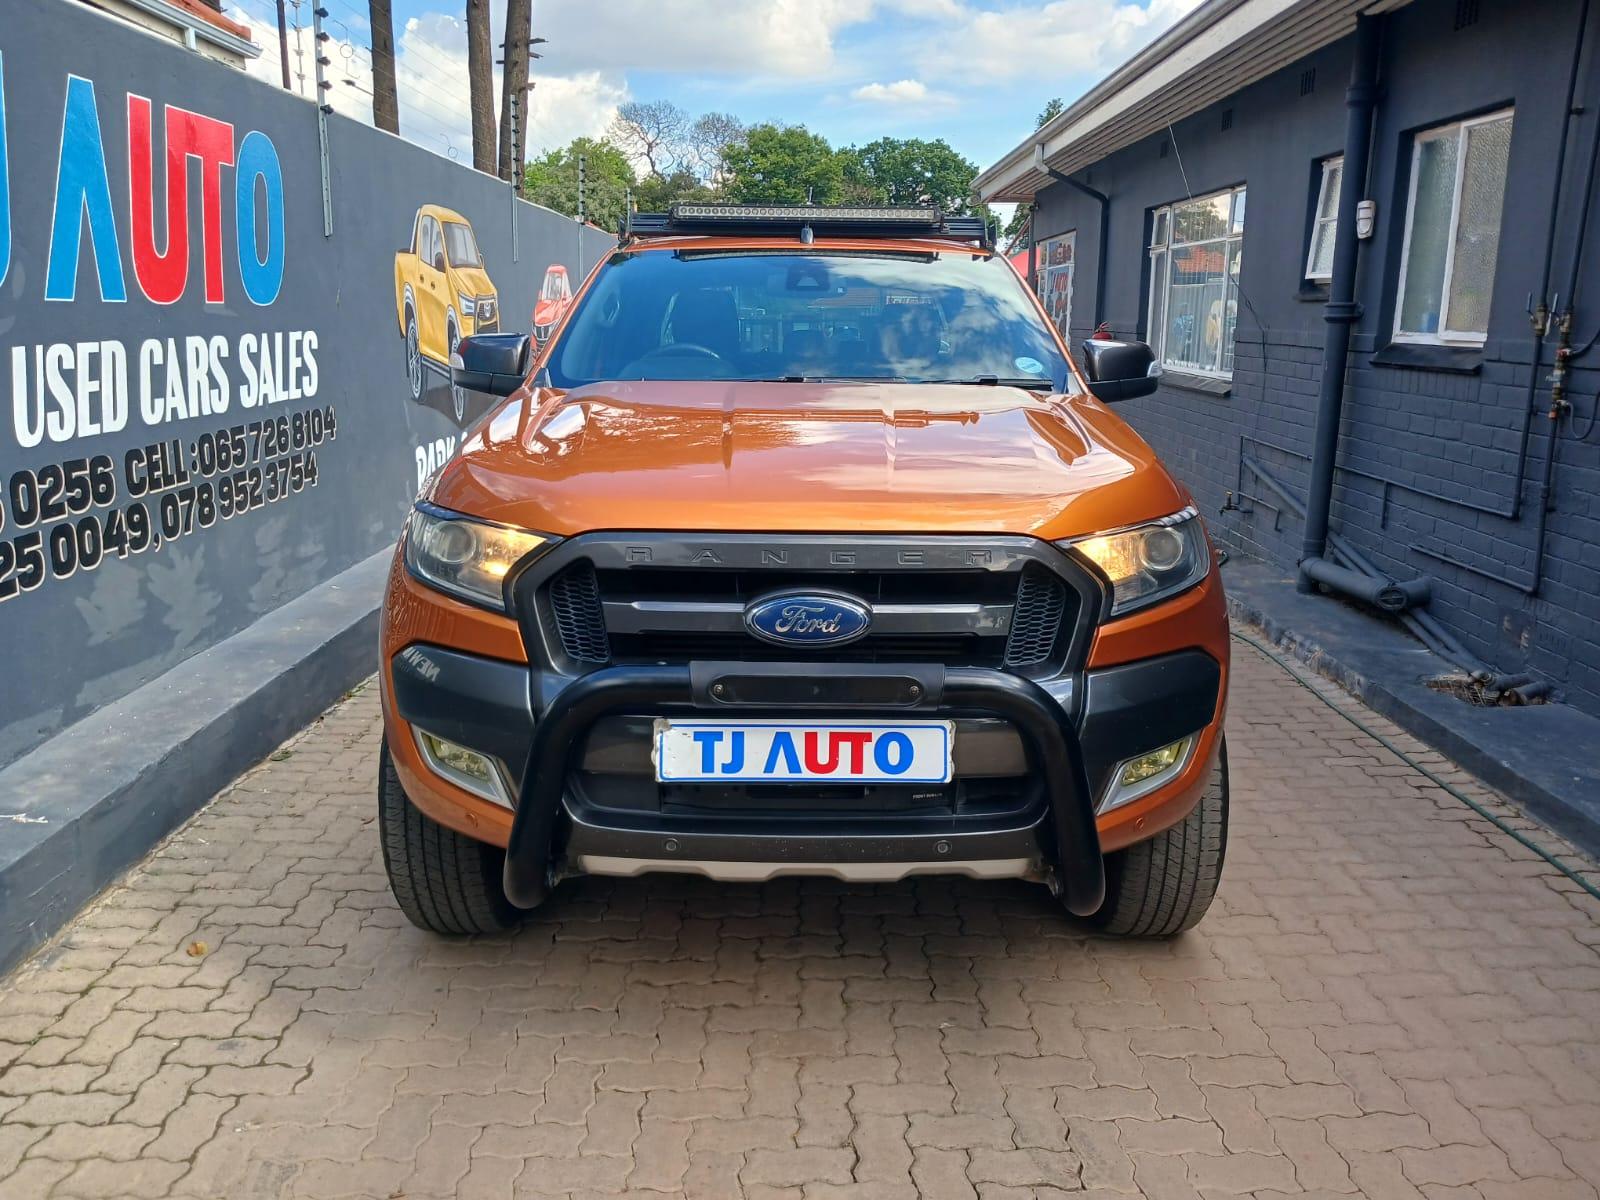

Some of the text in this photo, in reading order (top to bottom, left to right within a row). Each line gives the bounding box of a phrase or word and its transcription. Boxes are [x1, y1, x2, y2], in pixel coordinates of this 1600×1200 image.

[45, 73, 285, 306] AUTO
[12, 330, 318, 448] USED CARS SALES
[9, 455, 117, 529] 0256
[625, 546, 993, 566] RANGER
[774, 604, 841, 634] Ford
[693, 731, 914, 775] TJ AUTO
